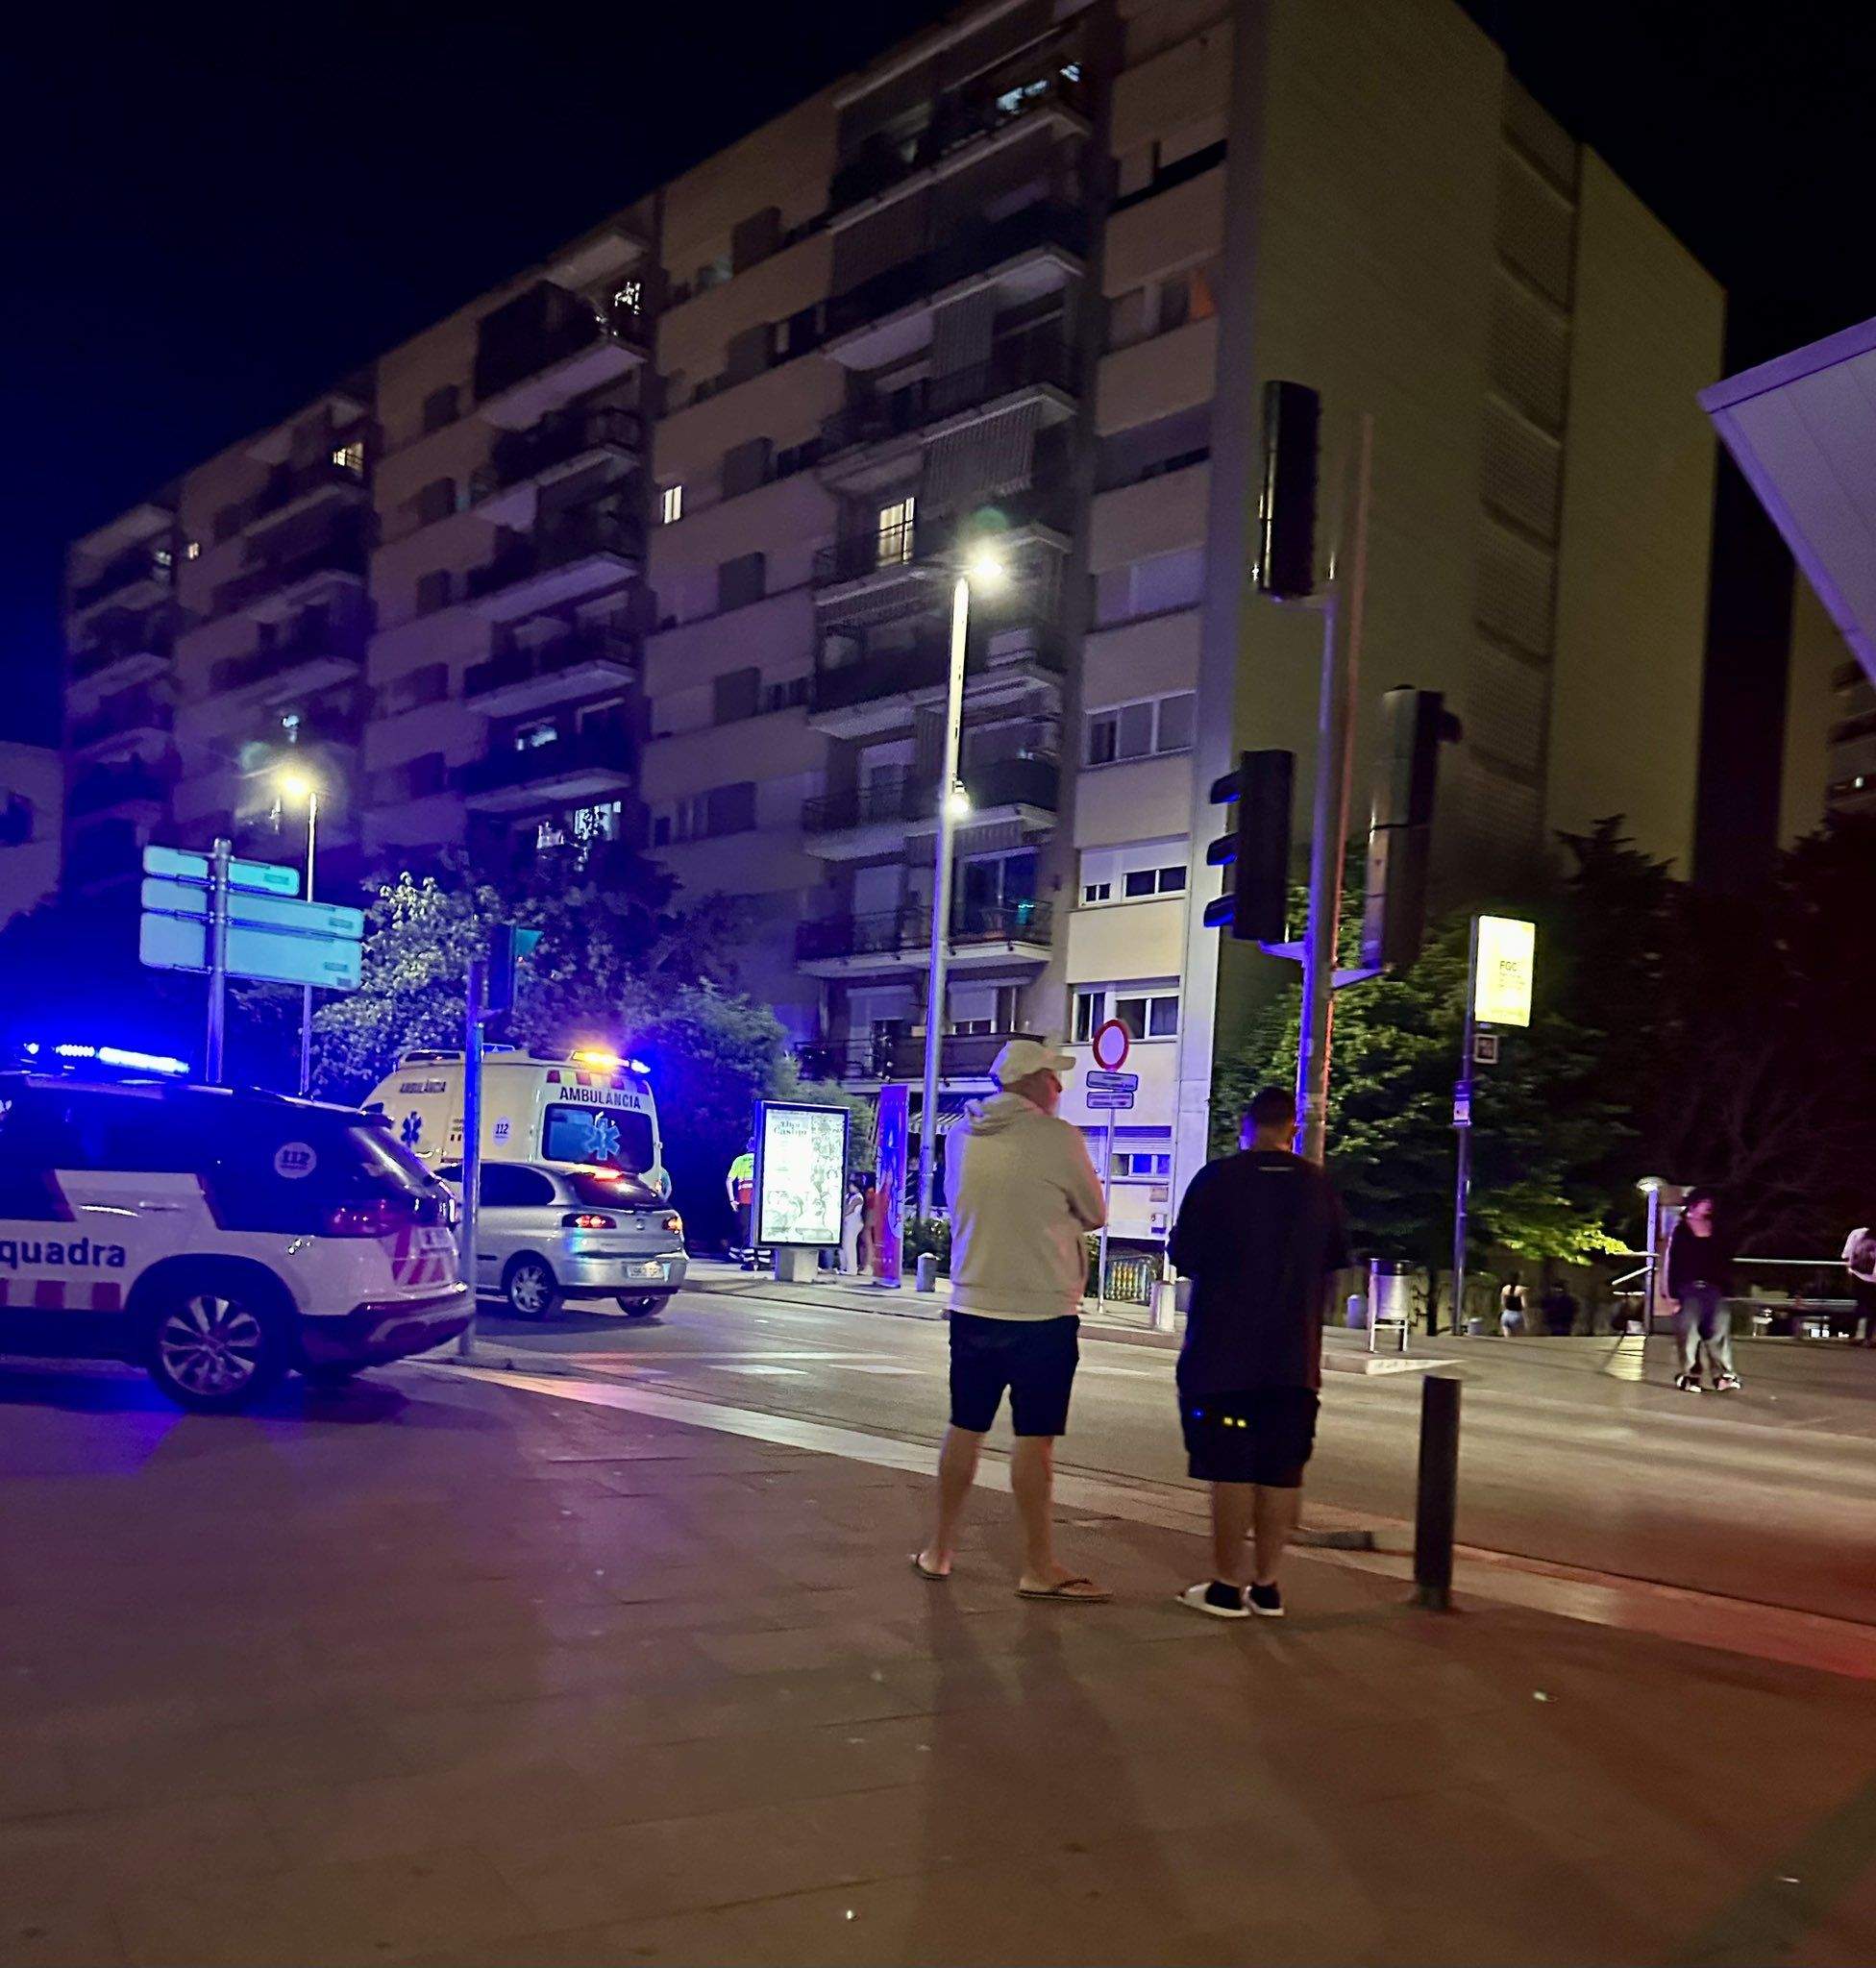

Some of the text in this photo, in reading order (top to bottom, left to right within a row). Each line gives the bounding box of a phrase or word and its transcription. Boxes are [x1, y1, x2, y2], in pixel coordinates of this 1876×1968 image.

[495, 1122, 509, 1135] 112
[283, 1149, 311, 1166] 112
[0, 1237, 126, 1270] quadra
